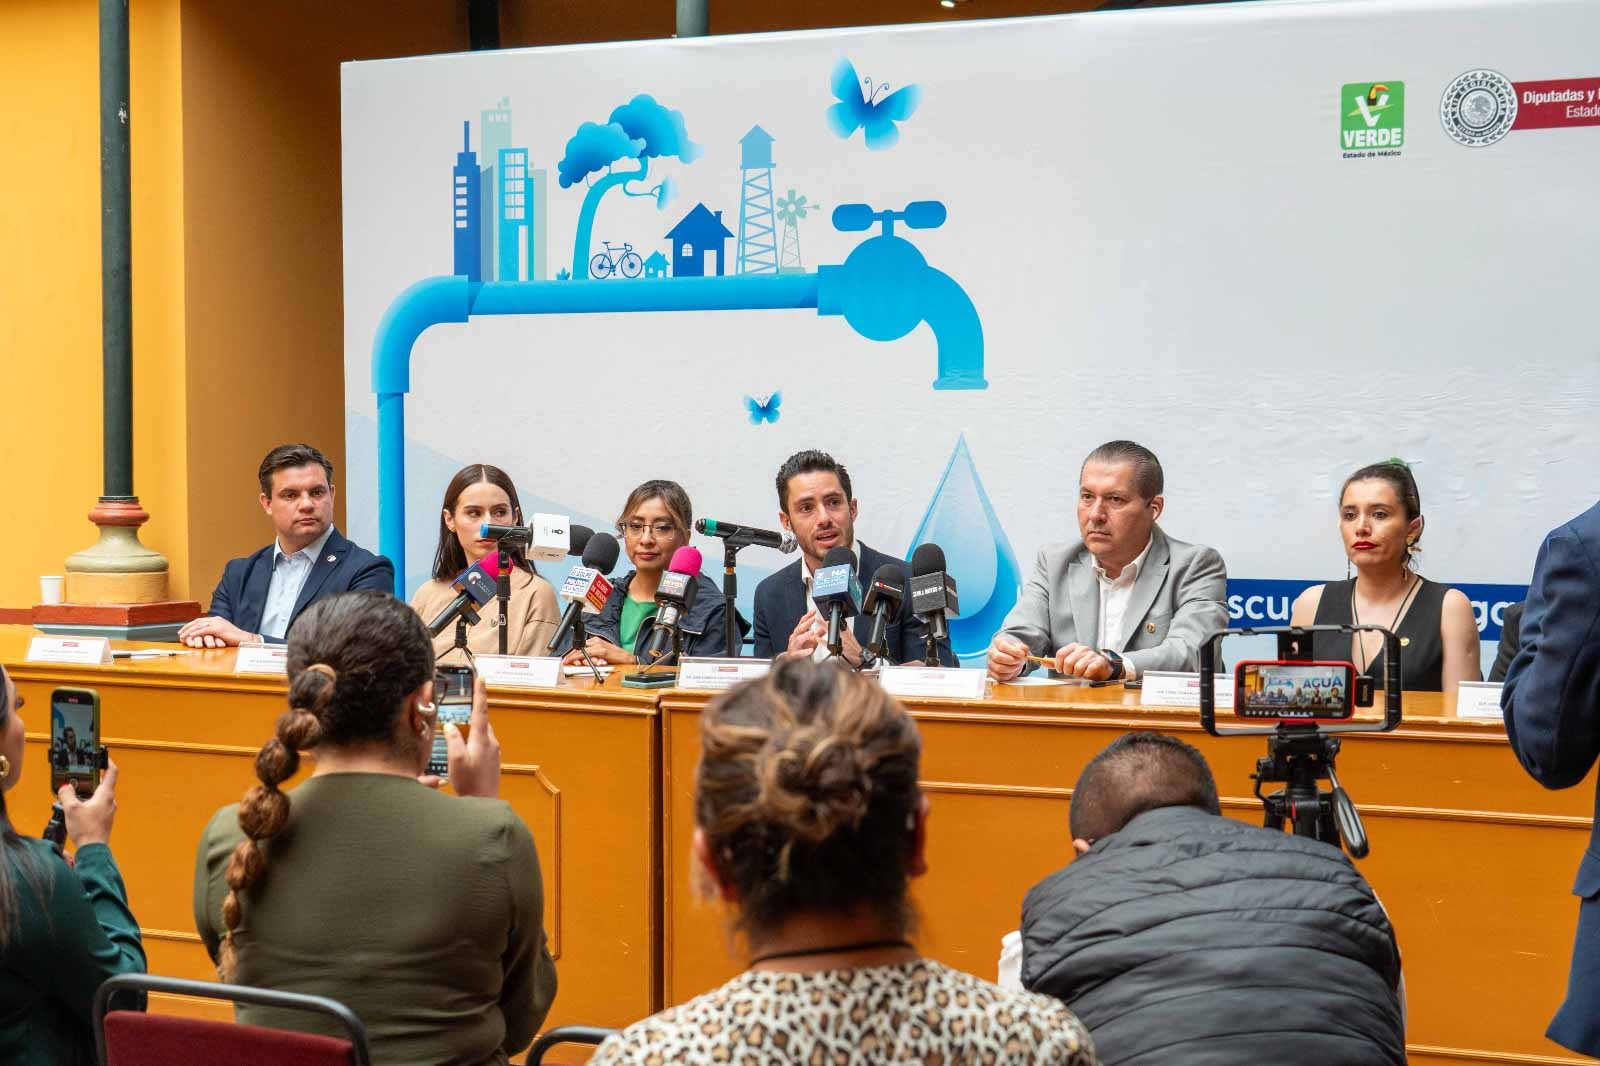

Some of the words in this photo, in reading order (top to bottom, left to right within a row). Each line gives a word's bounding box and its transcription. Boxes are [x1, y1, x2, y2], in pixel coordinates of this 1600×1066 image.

[1523, 89, 1584, 106] Diputadas
[1587, 89, 1595, 103] y
[1343, 128, 1402, 148] VERDE
[1228, 594, 1294, 620] scu
[1303, 676, 1343, 689] AGUA
